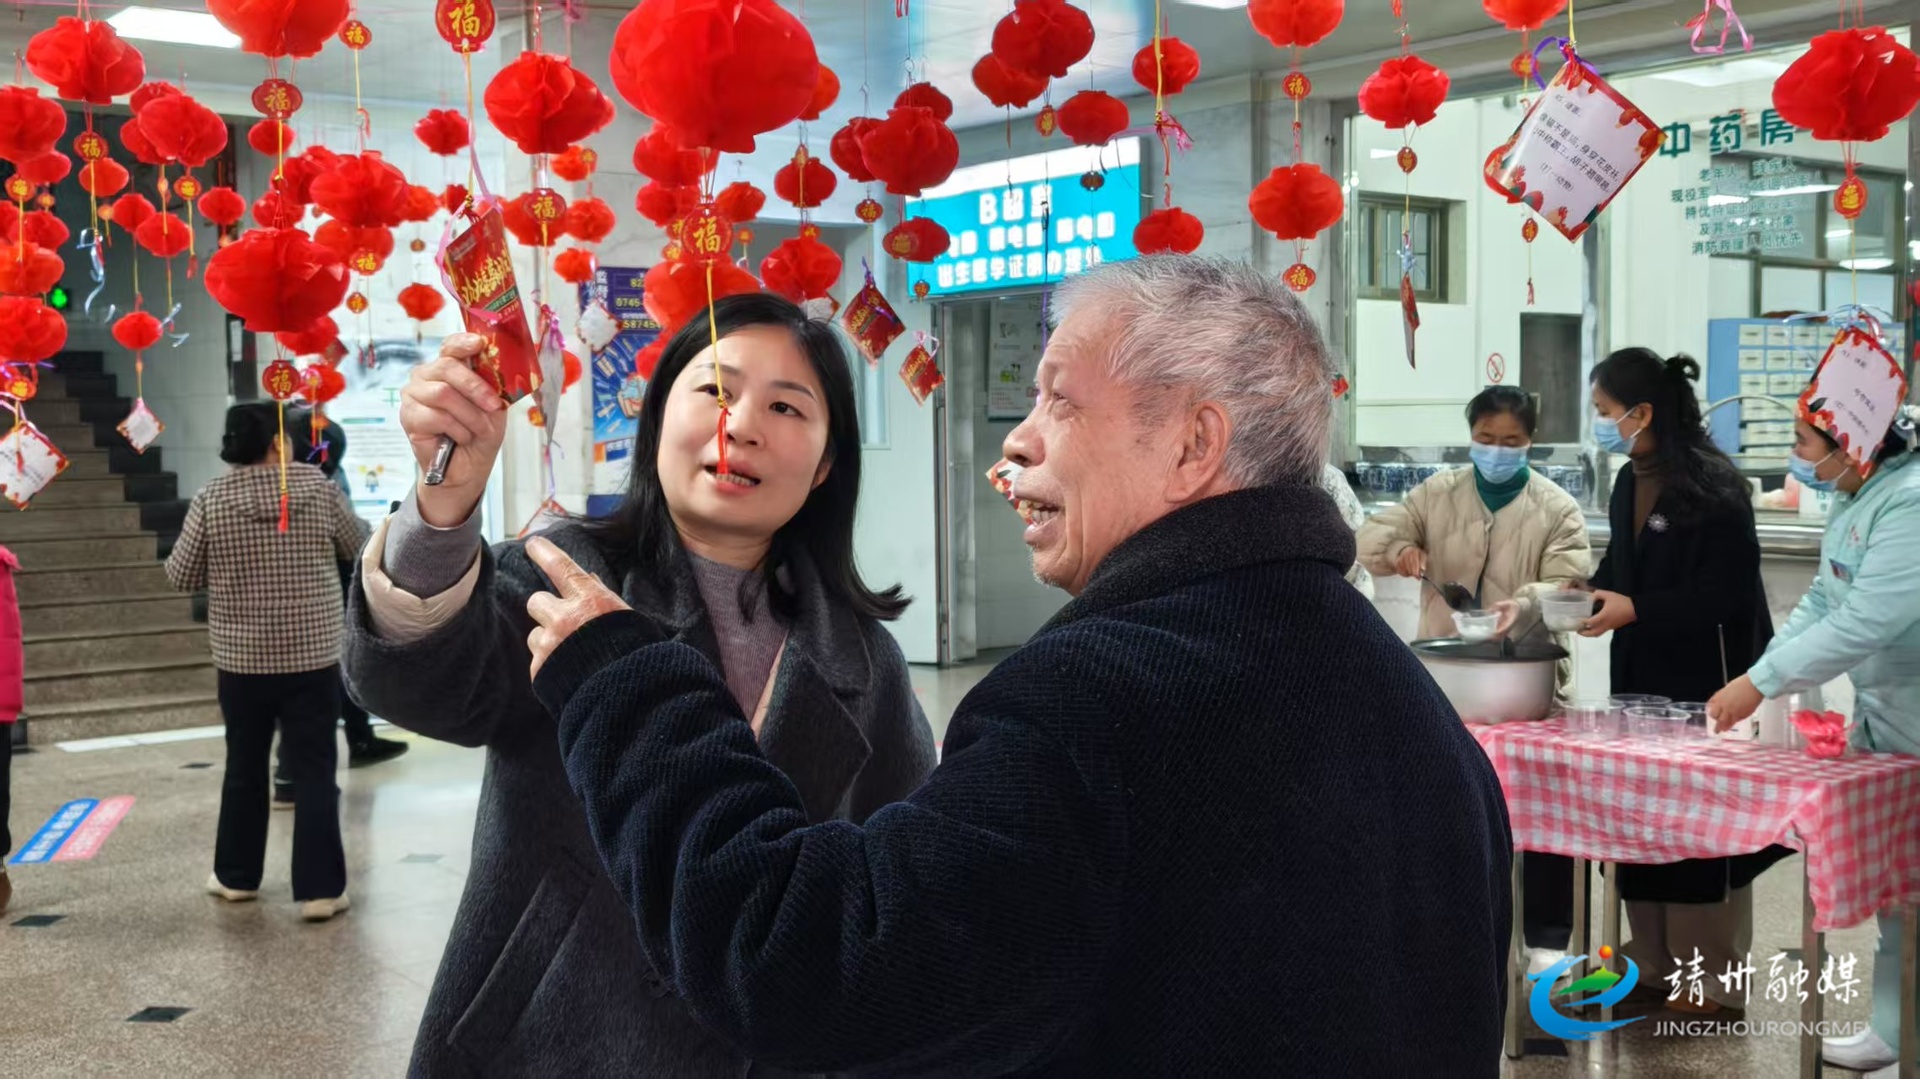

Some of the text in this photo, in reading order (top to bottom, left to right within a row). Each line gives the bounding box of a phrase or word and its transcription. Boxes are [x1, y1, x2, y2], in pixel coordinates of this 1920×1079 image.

[448, 0, 480, 38] 福
[345, 26, 365, 45] 福
[1288, 75, 1304, 94] 福
[264, 87, 291, 112] 福
[1659, 108, 1796, 158] 中药房
[82, 137, 101, 158] 福
[532, 195, 556, 220] 福
[861, 206, 877, 219] 福
[693, 215, 721, 255] 福
[356, 252, 376, 271] 福
[1290, 269, 1308, 286] 福
[271, 368, 292, 393] 福
